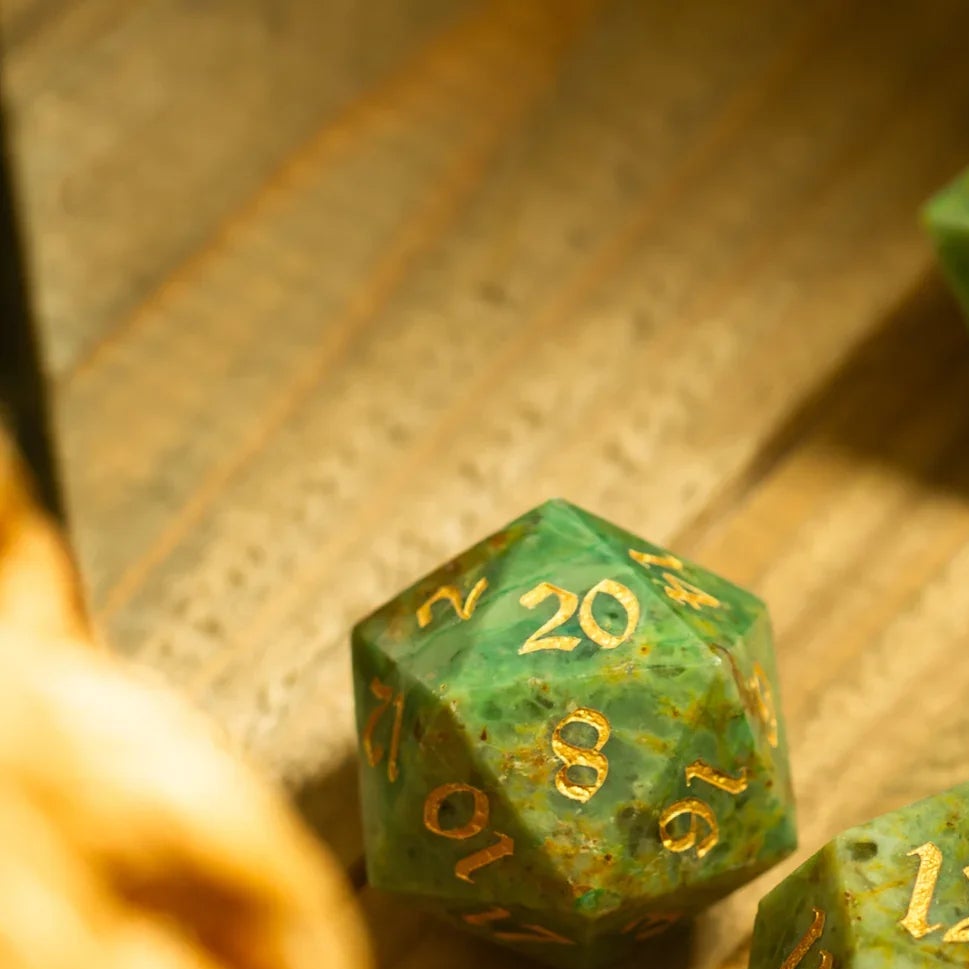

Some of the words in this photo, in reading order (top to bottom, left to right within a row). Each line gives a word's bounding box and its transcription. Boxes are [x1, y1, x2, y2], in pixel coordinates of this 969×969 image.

[416, 577, 489, 628] 2
[518, 578, 641, 655] 20
[551, 706, 611, 804] 8
[423, 782, 514, 884] 10
[659, 759, 748, 858] 16
